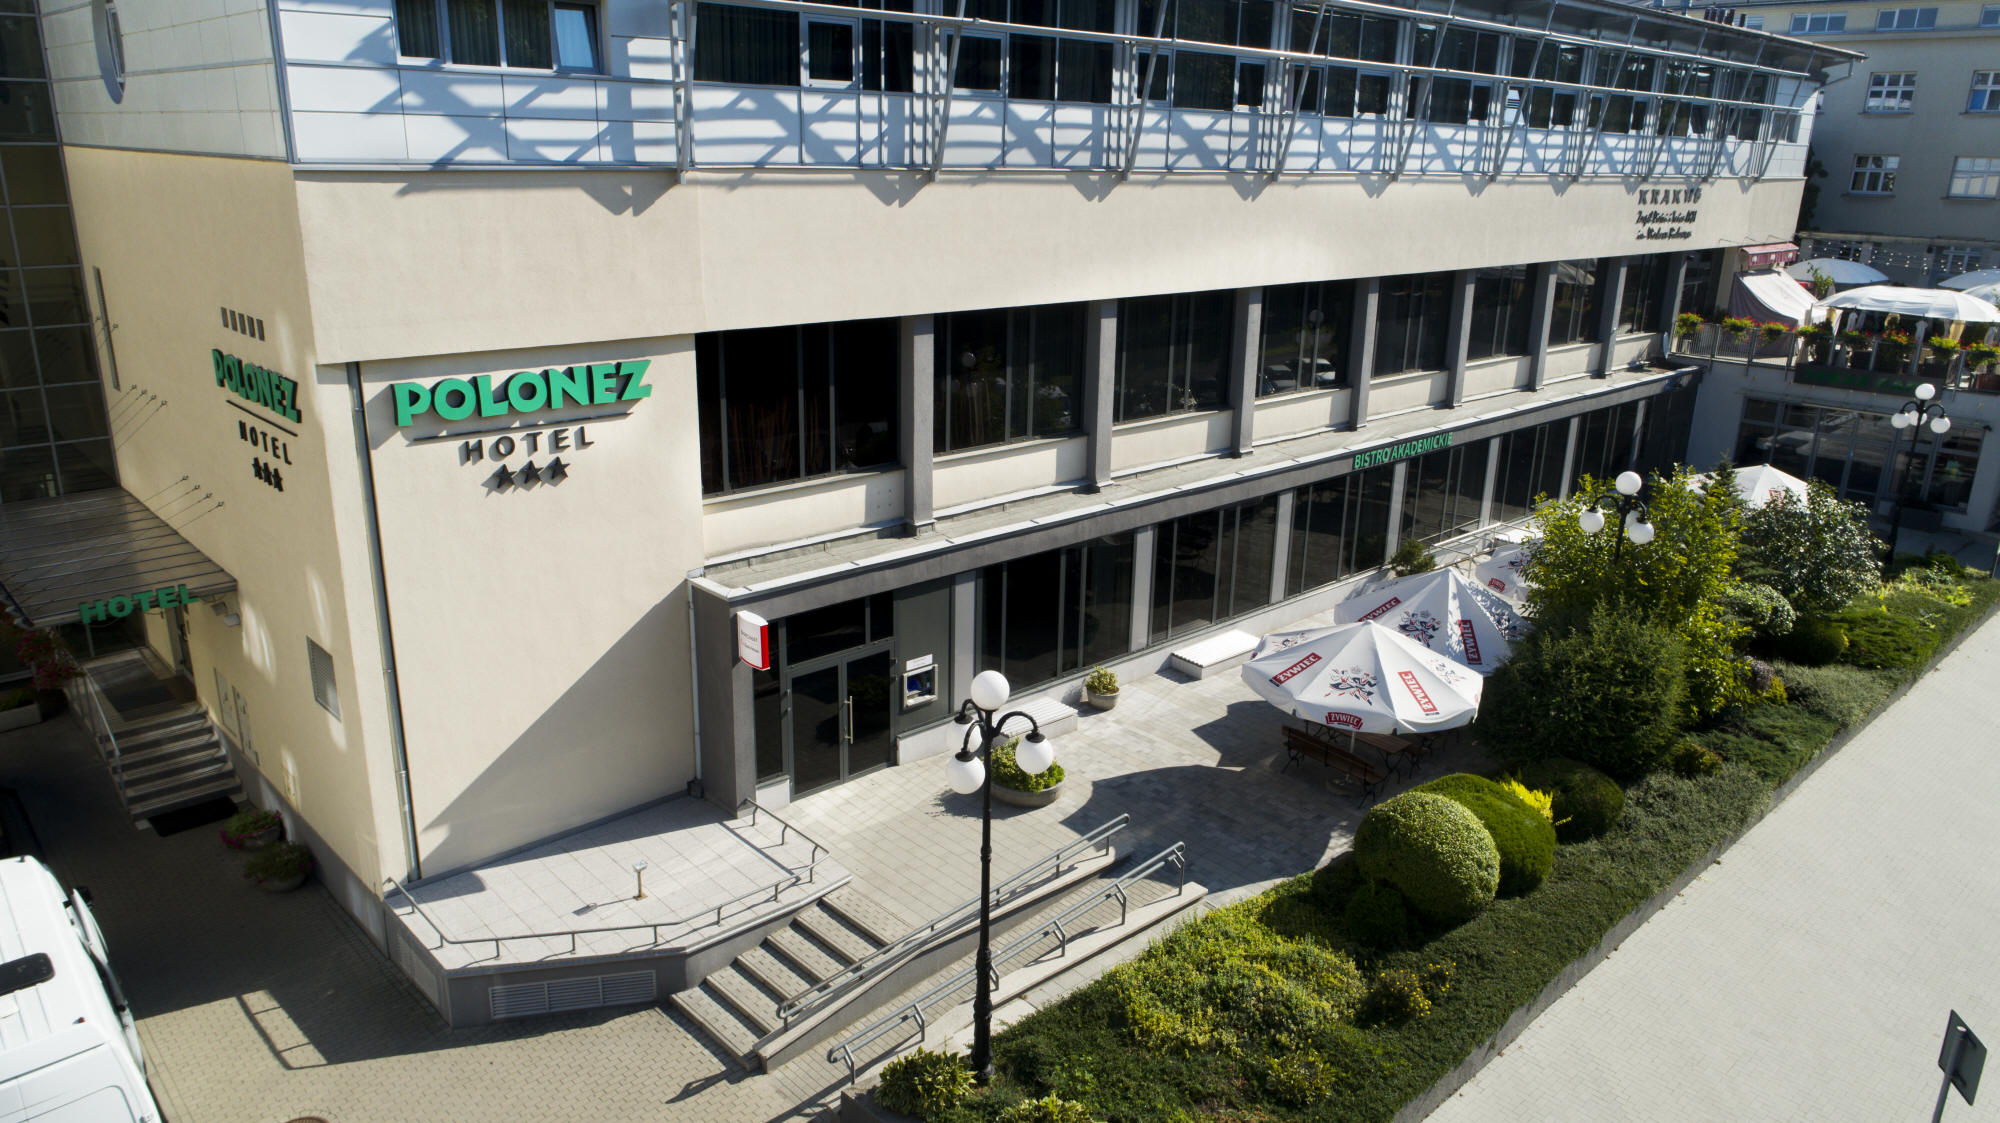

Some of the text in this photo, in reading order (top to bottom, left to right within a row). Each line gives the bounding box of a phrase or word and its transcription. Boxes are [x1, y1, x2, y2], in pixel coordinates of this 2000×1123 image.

[211, 348, 302, 424] POLONEZ
[391, 359, 653, 427] POLONEZ
[239, 420, 292, 465] HOTEL
[463, 426, 594, 464] HOTEL
[79, 584, 199, 624] HOTEL
